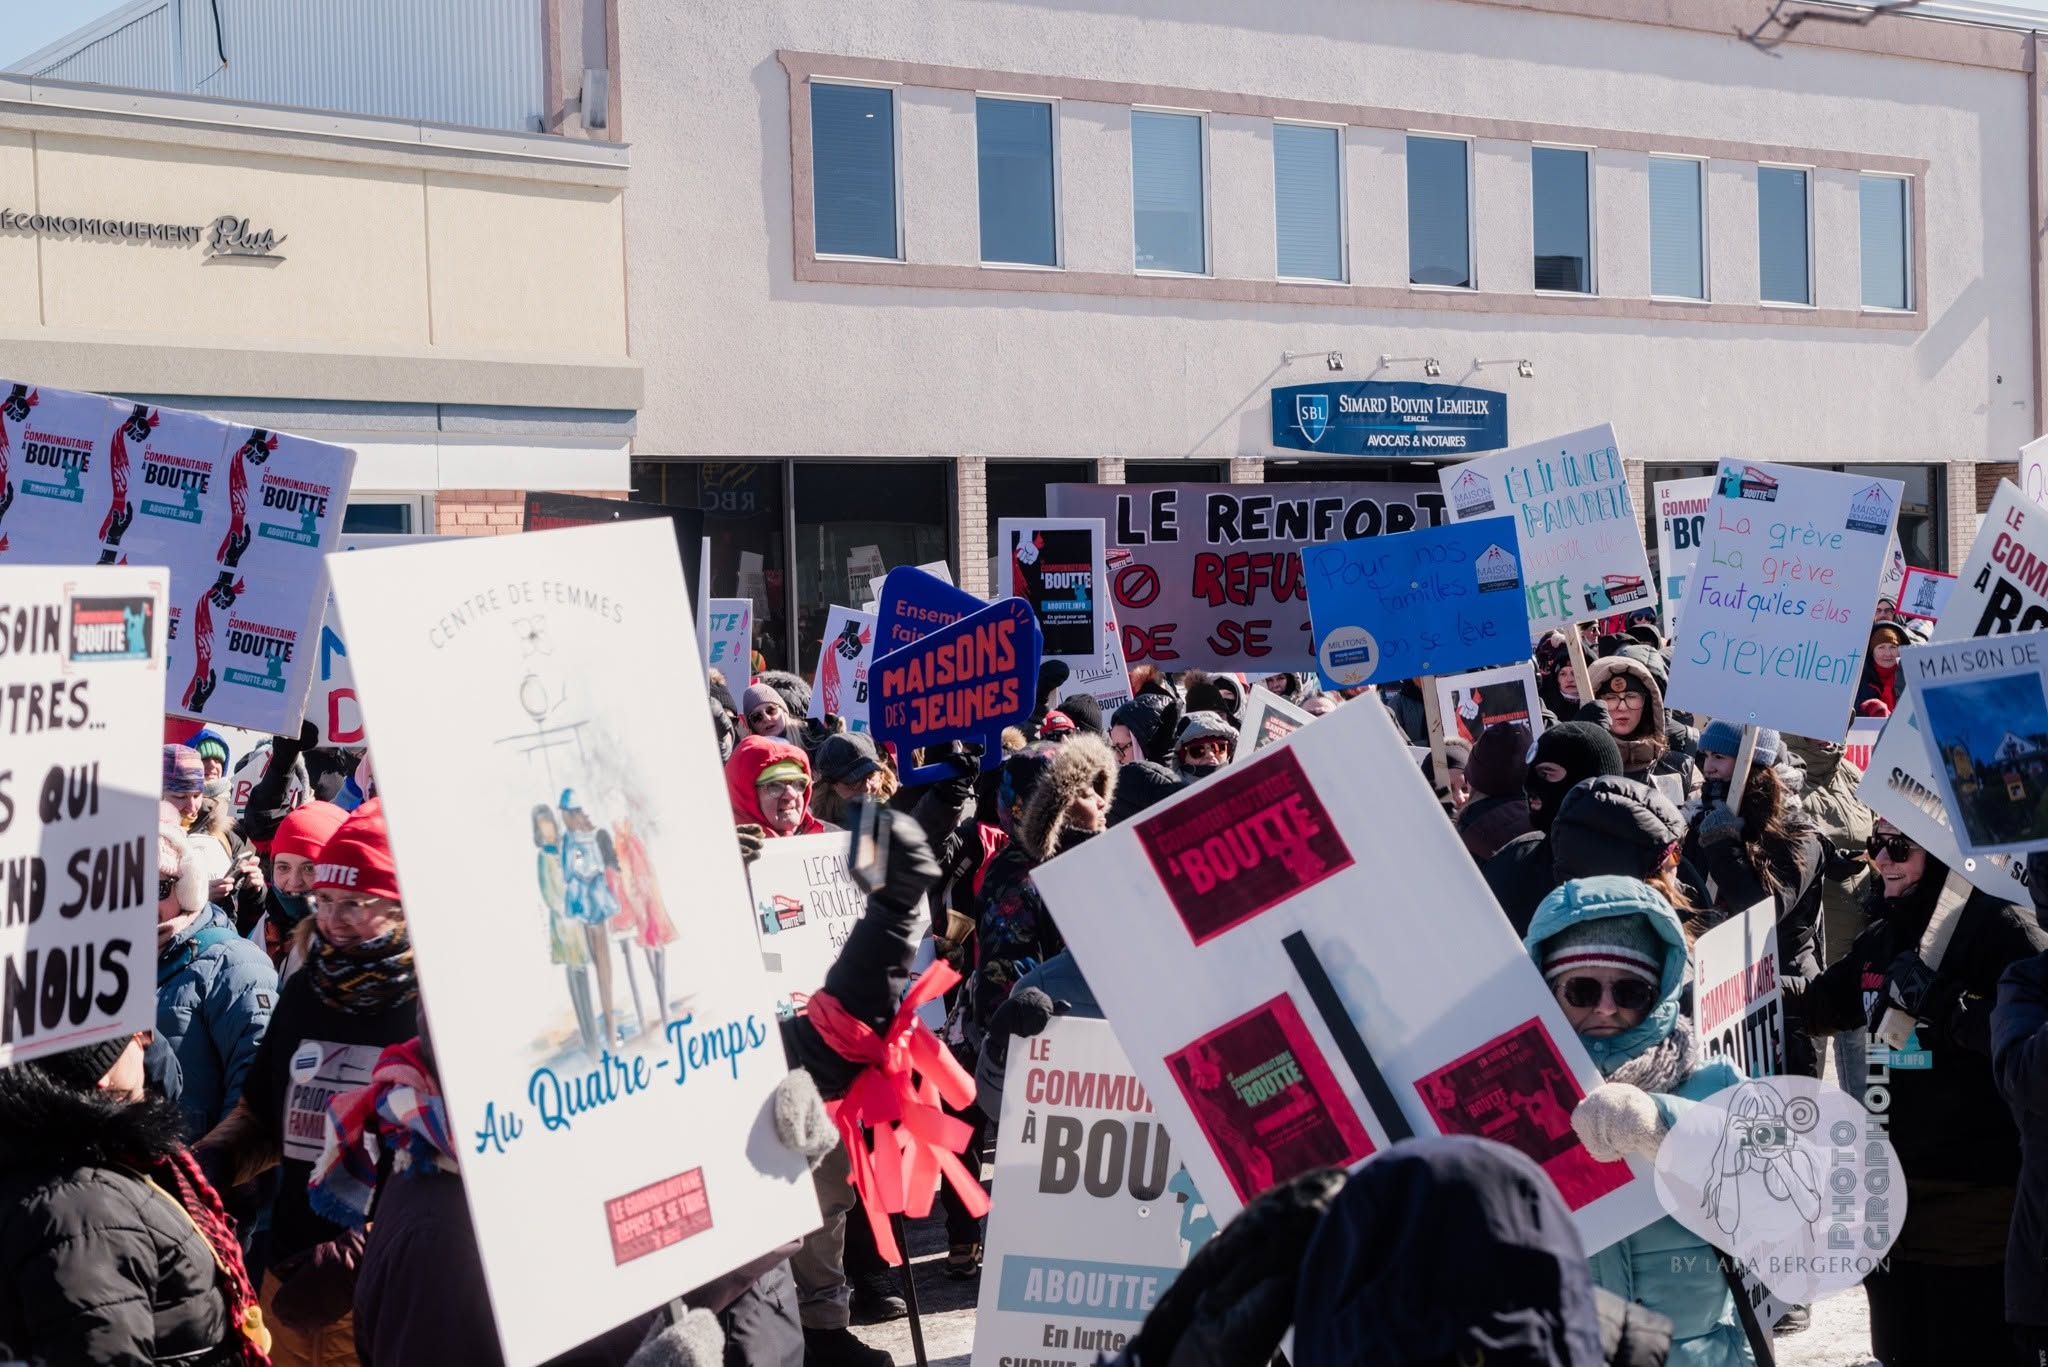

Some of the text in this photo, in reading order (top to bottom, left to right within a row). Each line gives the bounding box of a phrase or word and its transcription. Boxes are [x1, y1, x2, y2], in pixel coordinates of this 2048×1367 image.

[0, 207, 288, 250] ÉCONOMIQUEMENT Plus
[1302, 406, 1326, 420] SBL
[1339, 394, 1489, 415] SIMARD BOIVIN LEMIEUX
[24, 430, 93, 451] COMMUNAUTAIRE
[1367, 434, 1466, 447] AVOCATS & NOTAIRES
[25, 444, 91, 473] BOUTTE
[144, 451, 213, 473] COMMUNAUTAIRE
[145, 463, 211, 495] BOUTTE
[262, 473, 331, 496] COMMUNAUTAIRE
[1454, 487, 1491, 503] MAISON
[1661, 488, 1670, 499] LE
[263, 486, 329, 518] BOUTTE
[1116, 489, 1449, 546] LE RENFORT
[1850, 503, 1891, 518] MAISON
[1664, 517, 1671, 532] À
[1719, 507, 1751, 535] La
[1769, 522, 1842, 550] grève
[2006, 505, 2025, 532] LE
[1312, 541, 1467, 590] Pour nos
[1478, 563, 1517, 577] MAISON
[1712, 540, 1743, 570] La
[1973, 562, 1992, 594] À
[430, 581, 625, 649] CENTRE DE FEMMES
[1699, 575, 1747, 609] Faut
[1810, 597, 1851, 624] élus
[228, 618, 297, 641] COMMUNAUTAIRE
[1122, 623, 1180, 662] DE
[1207, 619, 1273, 658] SE
[1382, 637, 1409, 658] on
[1420, 632, 1442, 650] se
[229, 630, 295, 663] BOUTTE
[883, 618, 1015, 699] MAISONS
[2011, 643, 2040, 665] DE
[885, 677, 1019, 735] DES JEUNES
[40, 763, 100, 825] QUI
[1179, 791, 1321, 896] BOUTTE
[59, 835, 145, 919] SOIN
[2, 938, 132, 1045] NOUS
[1701, 953, 1776, 1035] COMMUNAUTAIRE
[1030, 1039, 1050, 1061] LE
[1240, 1060, 1304, 1107] BOUTTE
[475, 1101, 523, 1153] Au
[1021, 1109, 1036, 1144] À
[1043, 1324, 1126, 1352] En lutte
